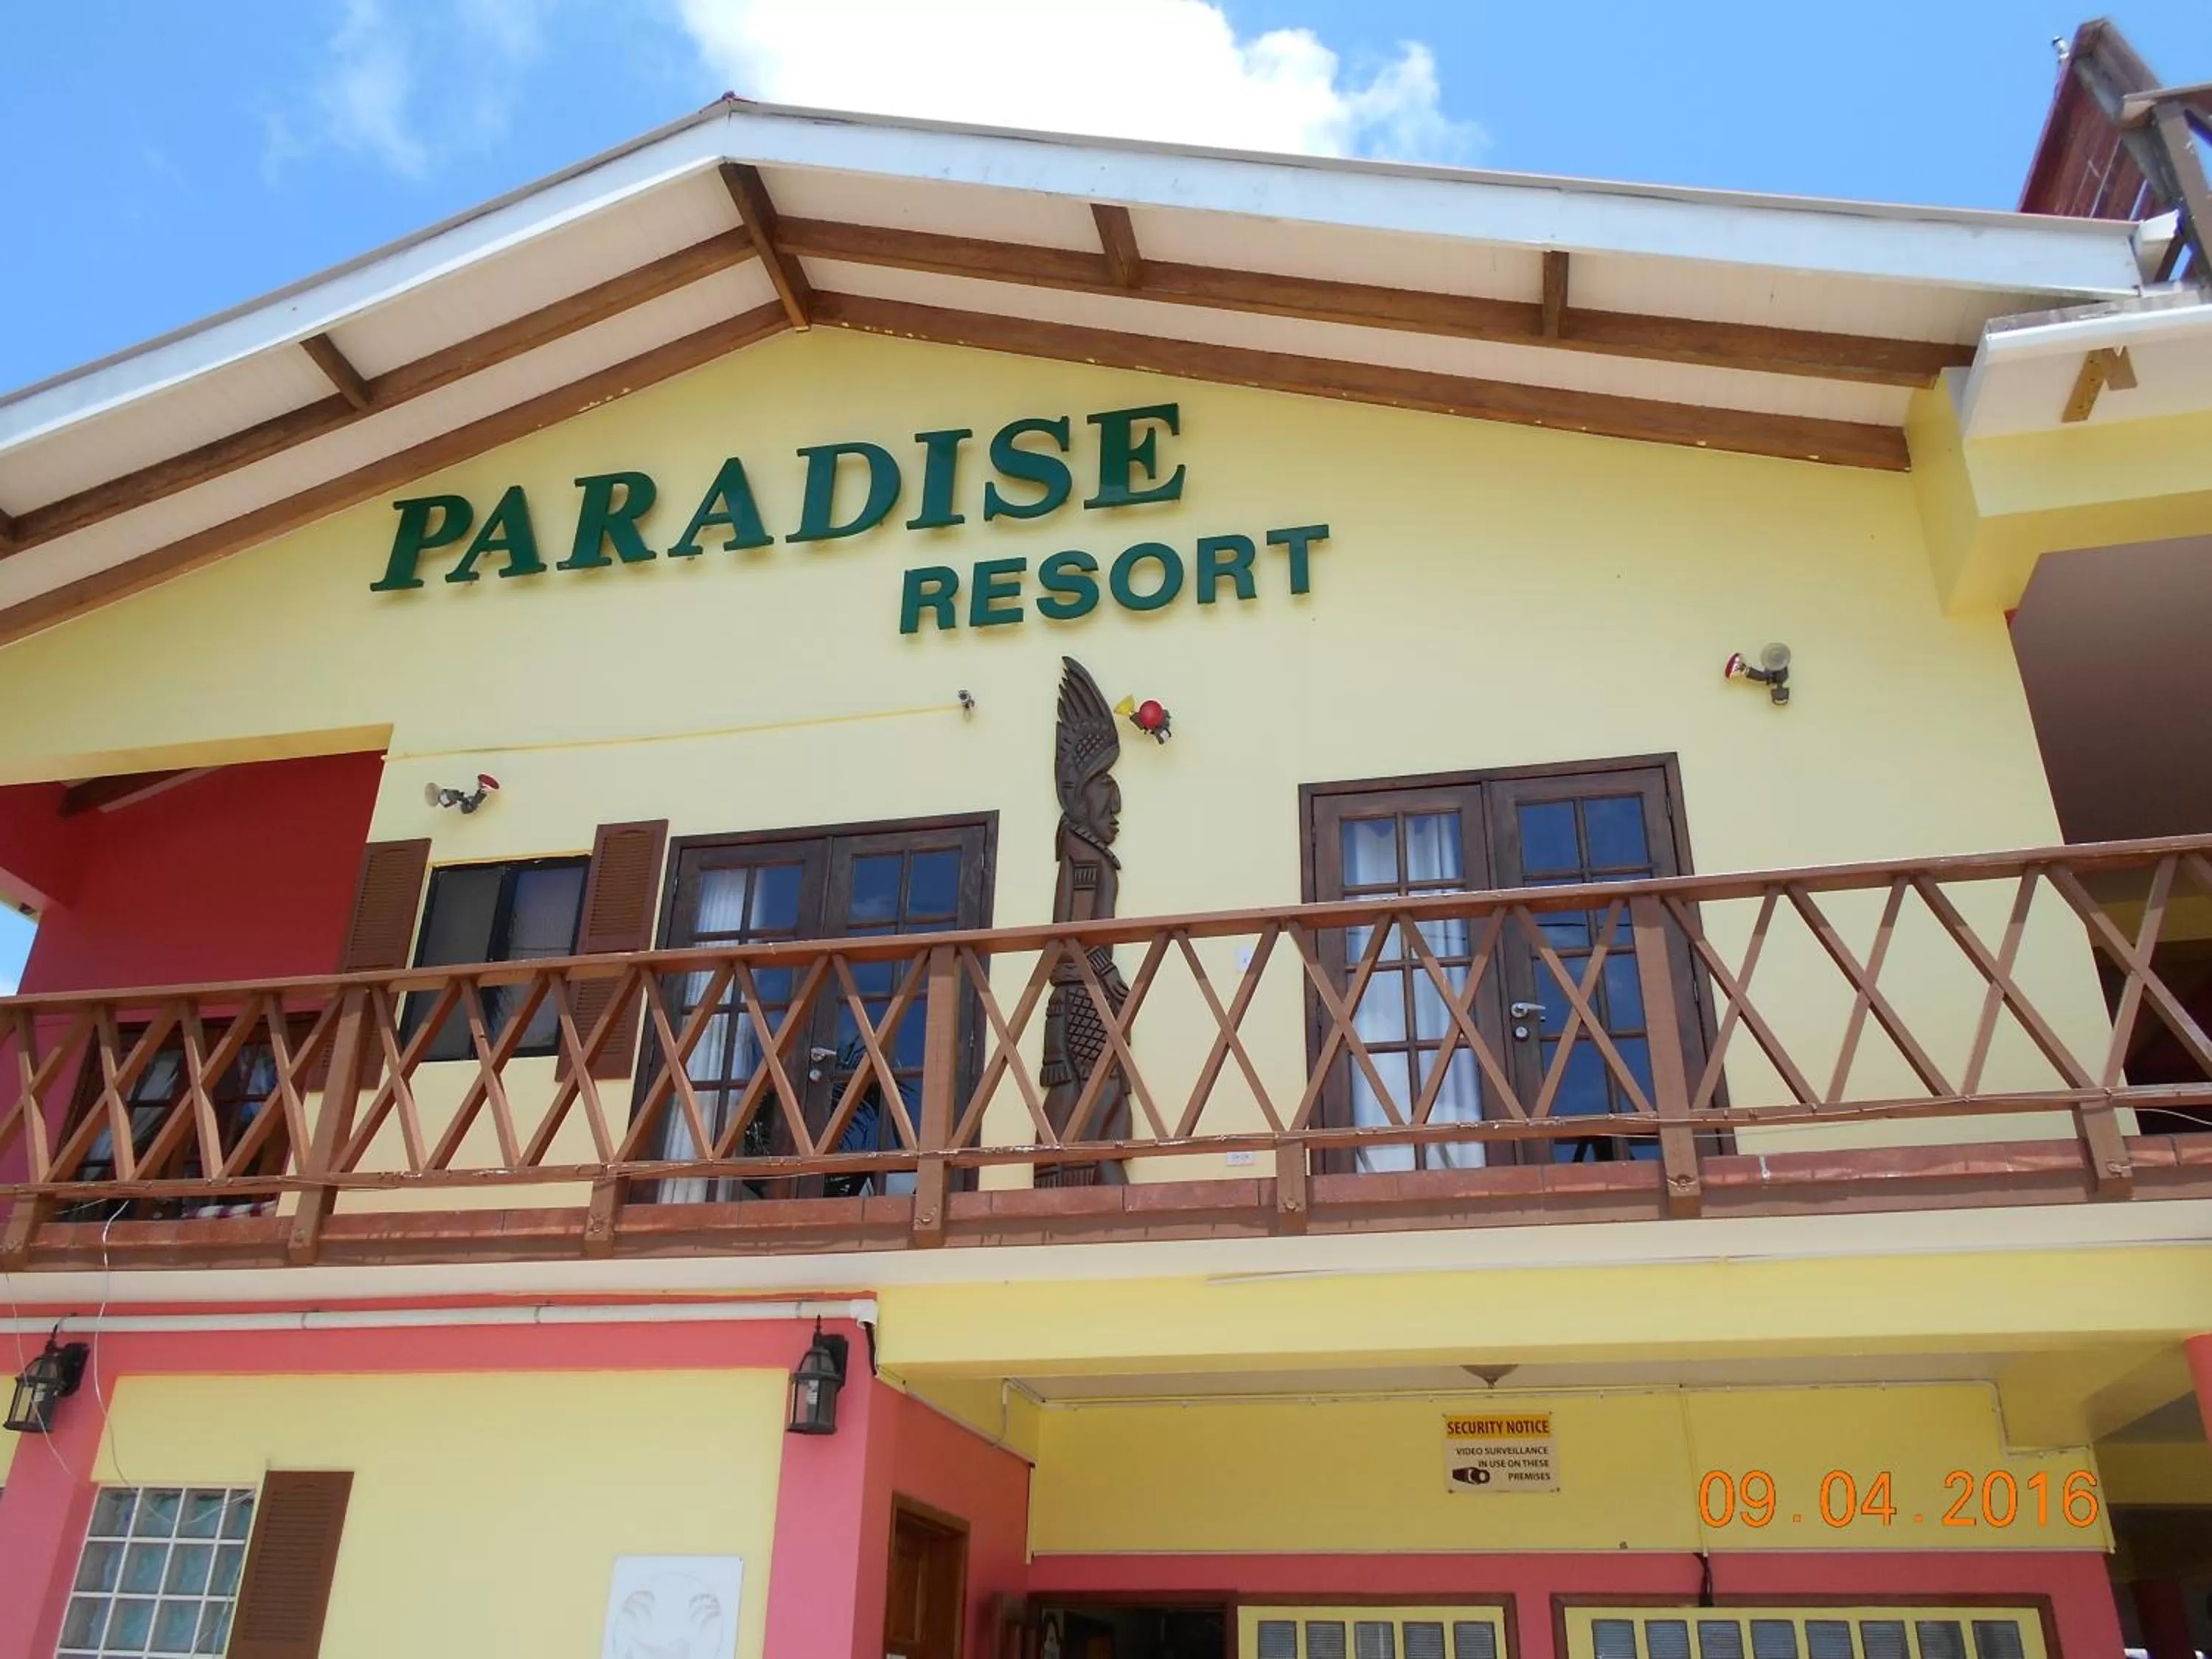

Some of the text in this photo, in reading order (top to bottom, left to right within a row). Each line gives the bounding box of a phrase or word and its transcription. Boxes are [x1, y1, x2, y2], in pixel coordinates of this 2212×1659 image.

[370, 403, 1186, 591] PARADISE
[900, 524, 1329, 633] RESORT
[1447, 1420, 1549, 1434] SECURITY NOTICE
[1456, 1446, 1548, 1455] VIDEO SURVEILLANCE
[1478, 1459, 1549, 1468] IN USE ON THESE
[1509, 1472, 1551, 1481] PREMISES
